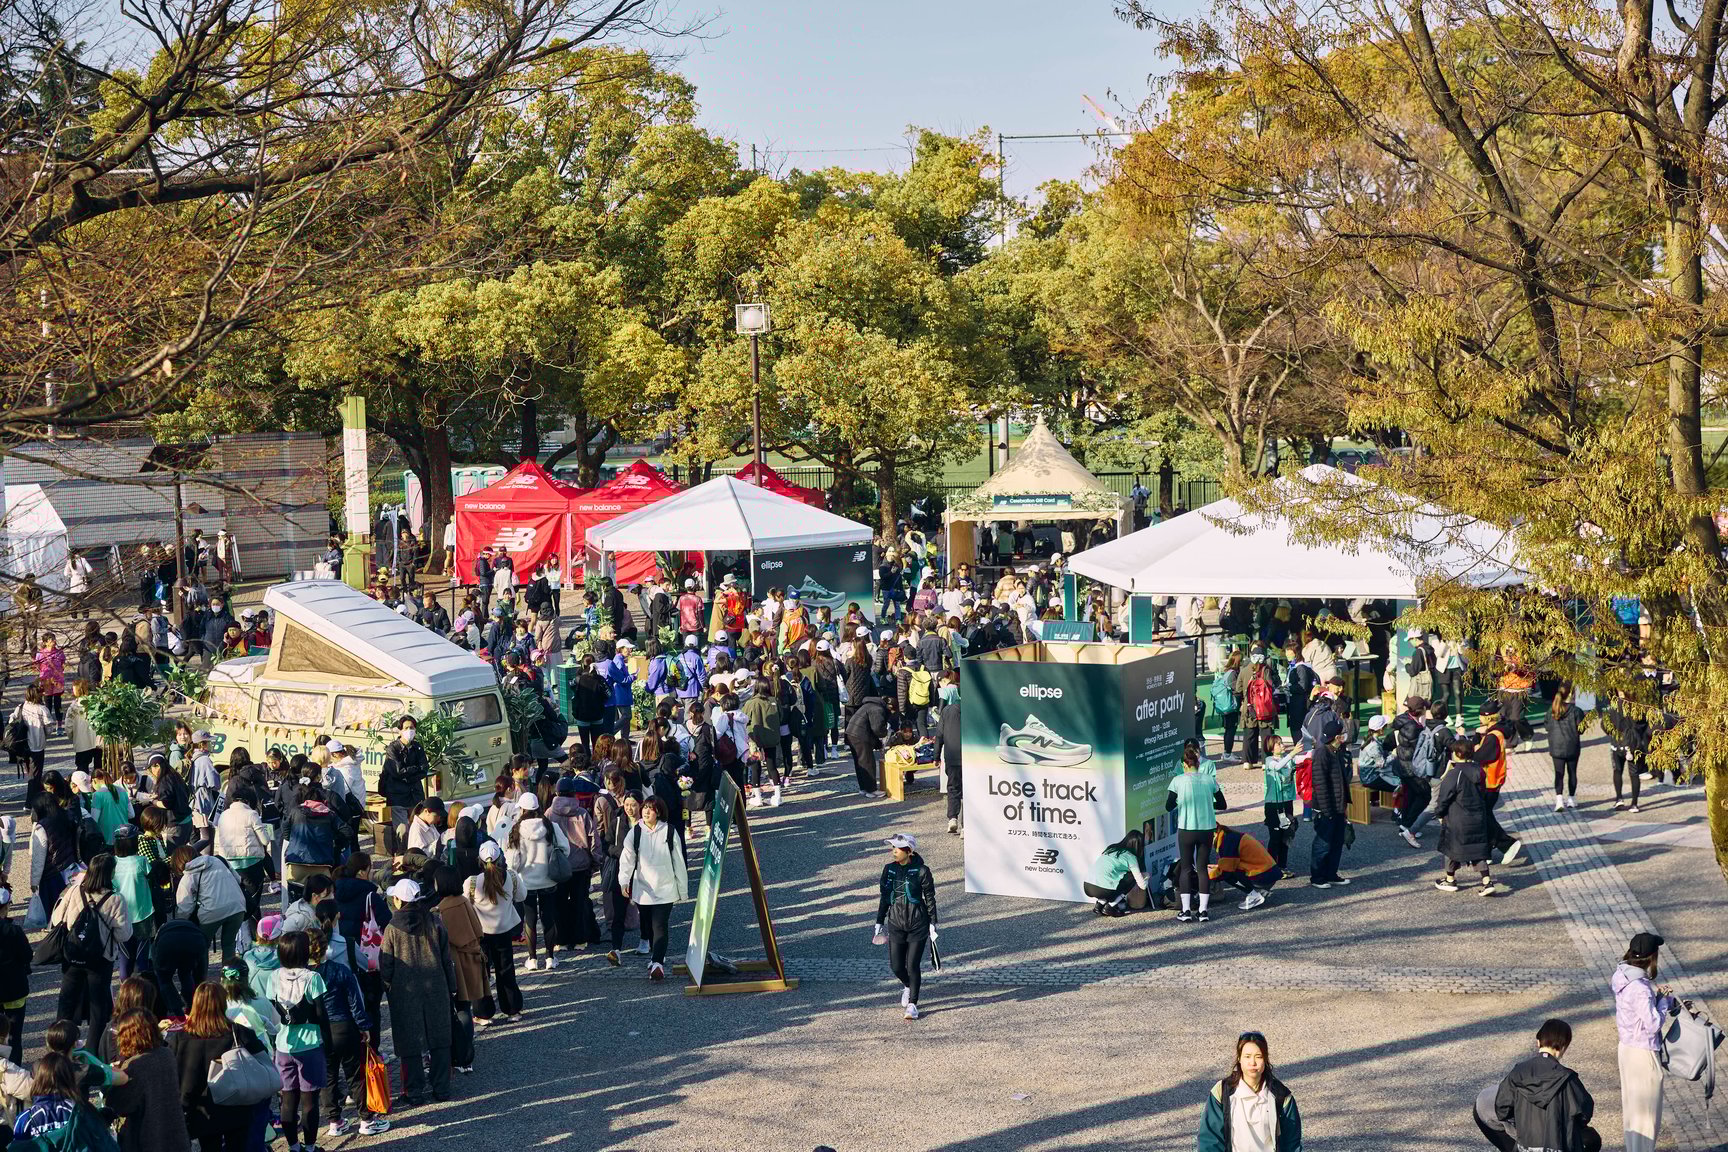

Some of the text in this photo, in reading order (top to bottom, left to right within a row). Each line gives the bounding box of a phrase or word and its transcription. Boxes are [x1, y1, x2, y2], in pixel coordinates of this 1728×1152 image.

[478, 502, 506, 510] balance
[760, 560, 784, 570] ellipse
[1019, 683, 1063, 701] ellipse
[1135, 690, 1185, 722] after party
[264, 737, 299, 757] Lose
[365, 746, 386, 766] tim
[988, 775, 1098, 802] Lose track
[1003, 800, 1082, 825] of time.
[1038, 865, 1064, 874] balance
